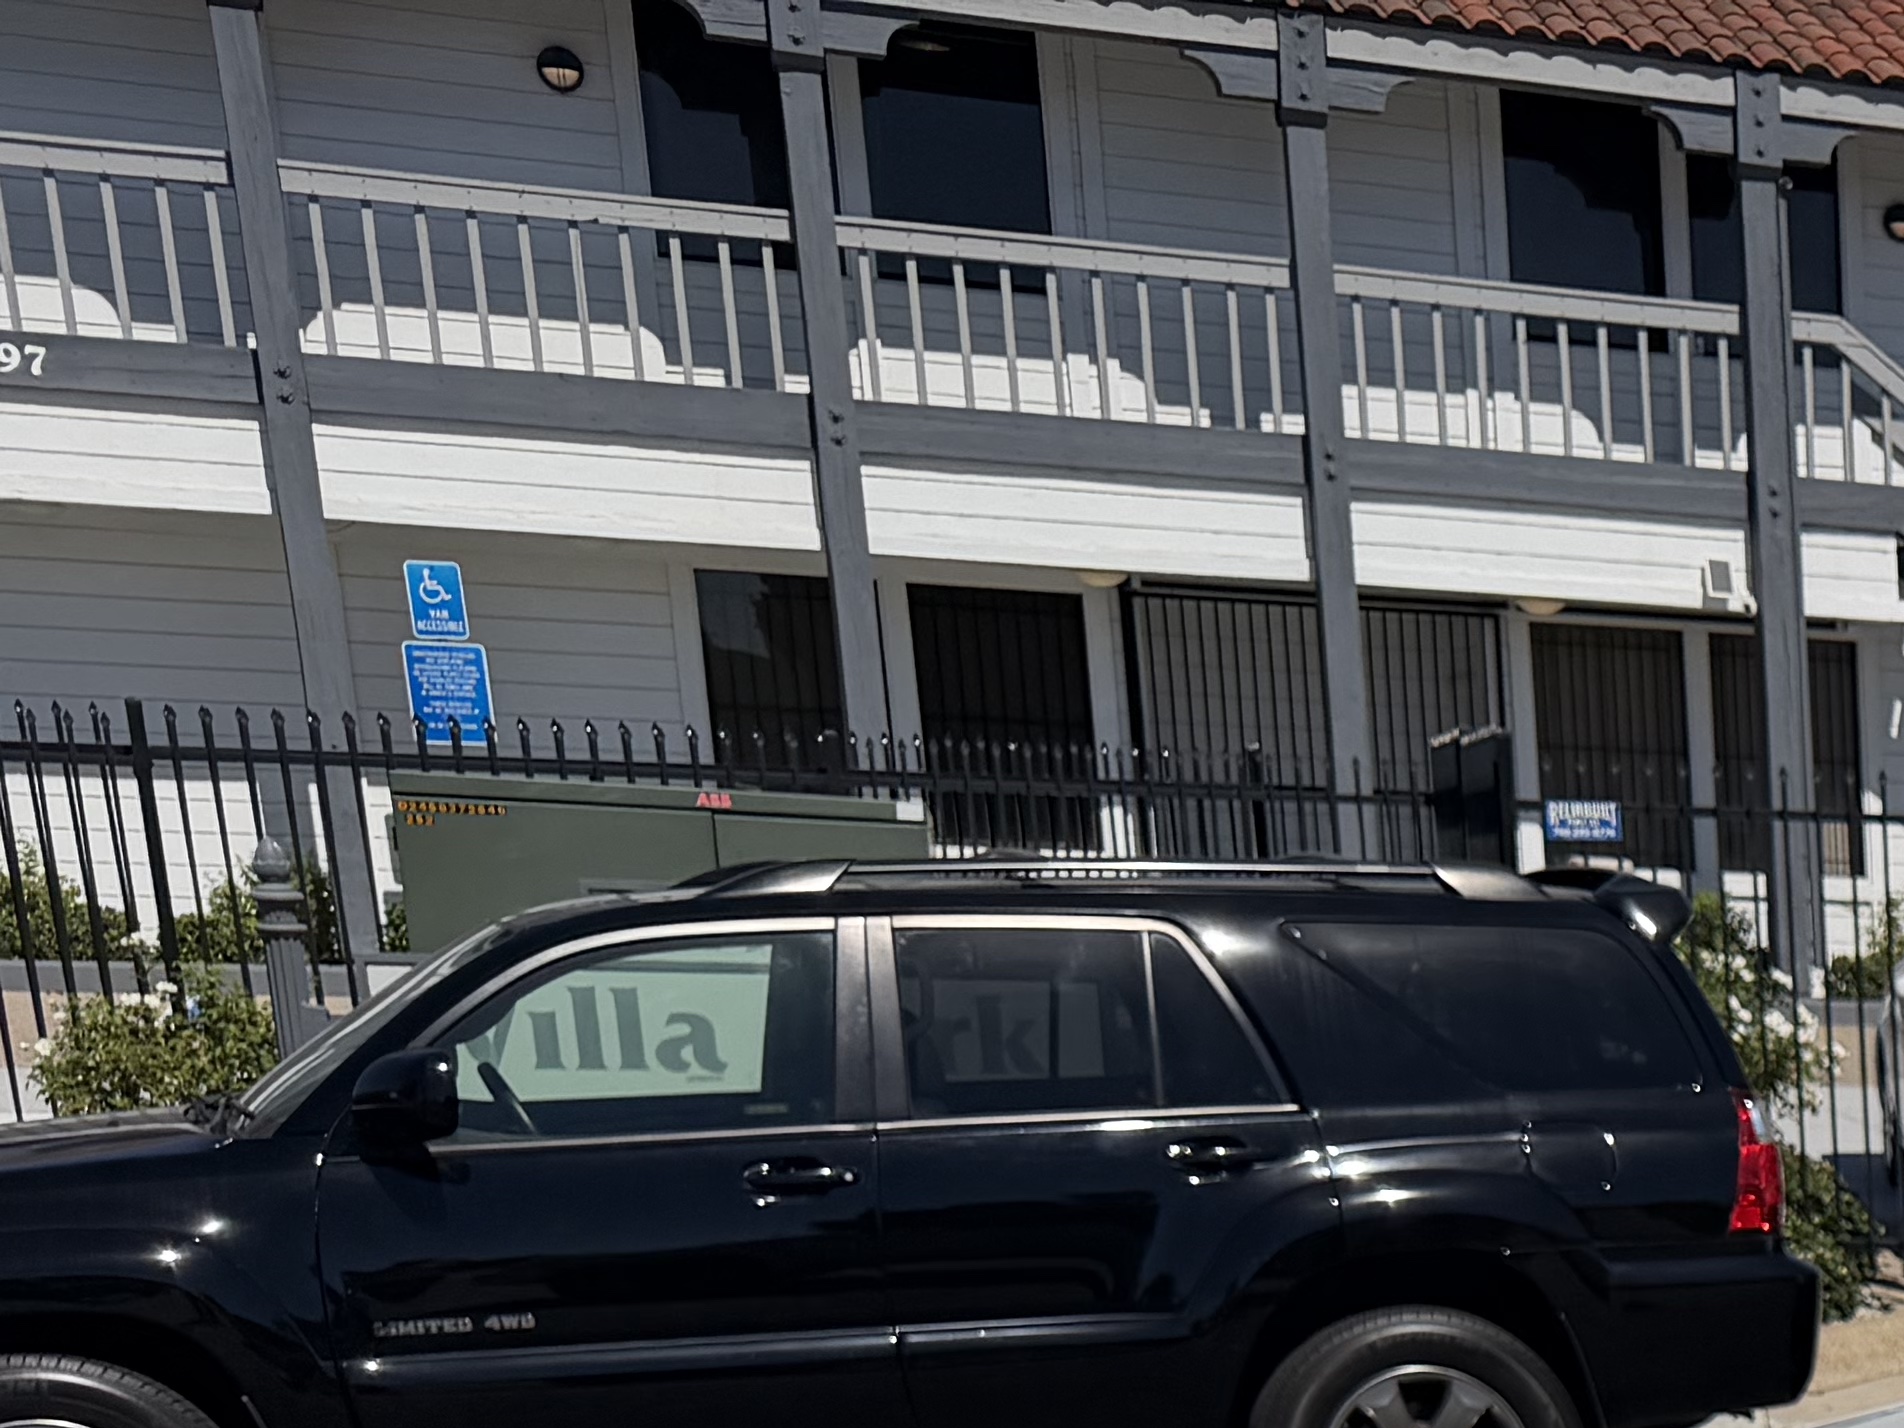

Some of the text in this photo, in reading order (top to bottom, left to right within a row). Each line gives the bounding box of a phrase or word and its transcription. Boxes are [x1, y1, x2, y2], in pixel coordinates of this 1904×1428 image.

[931, 994, 1049, 1074] rk
[373, 1312, 536, 1337] LIMITED 4WD
